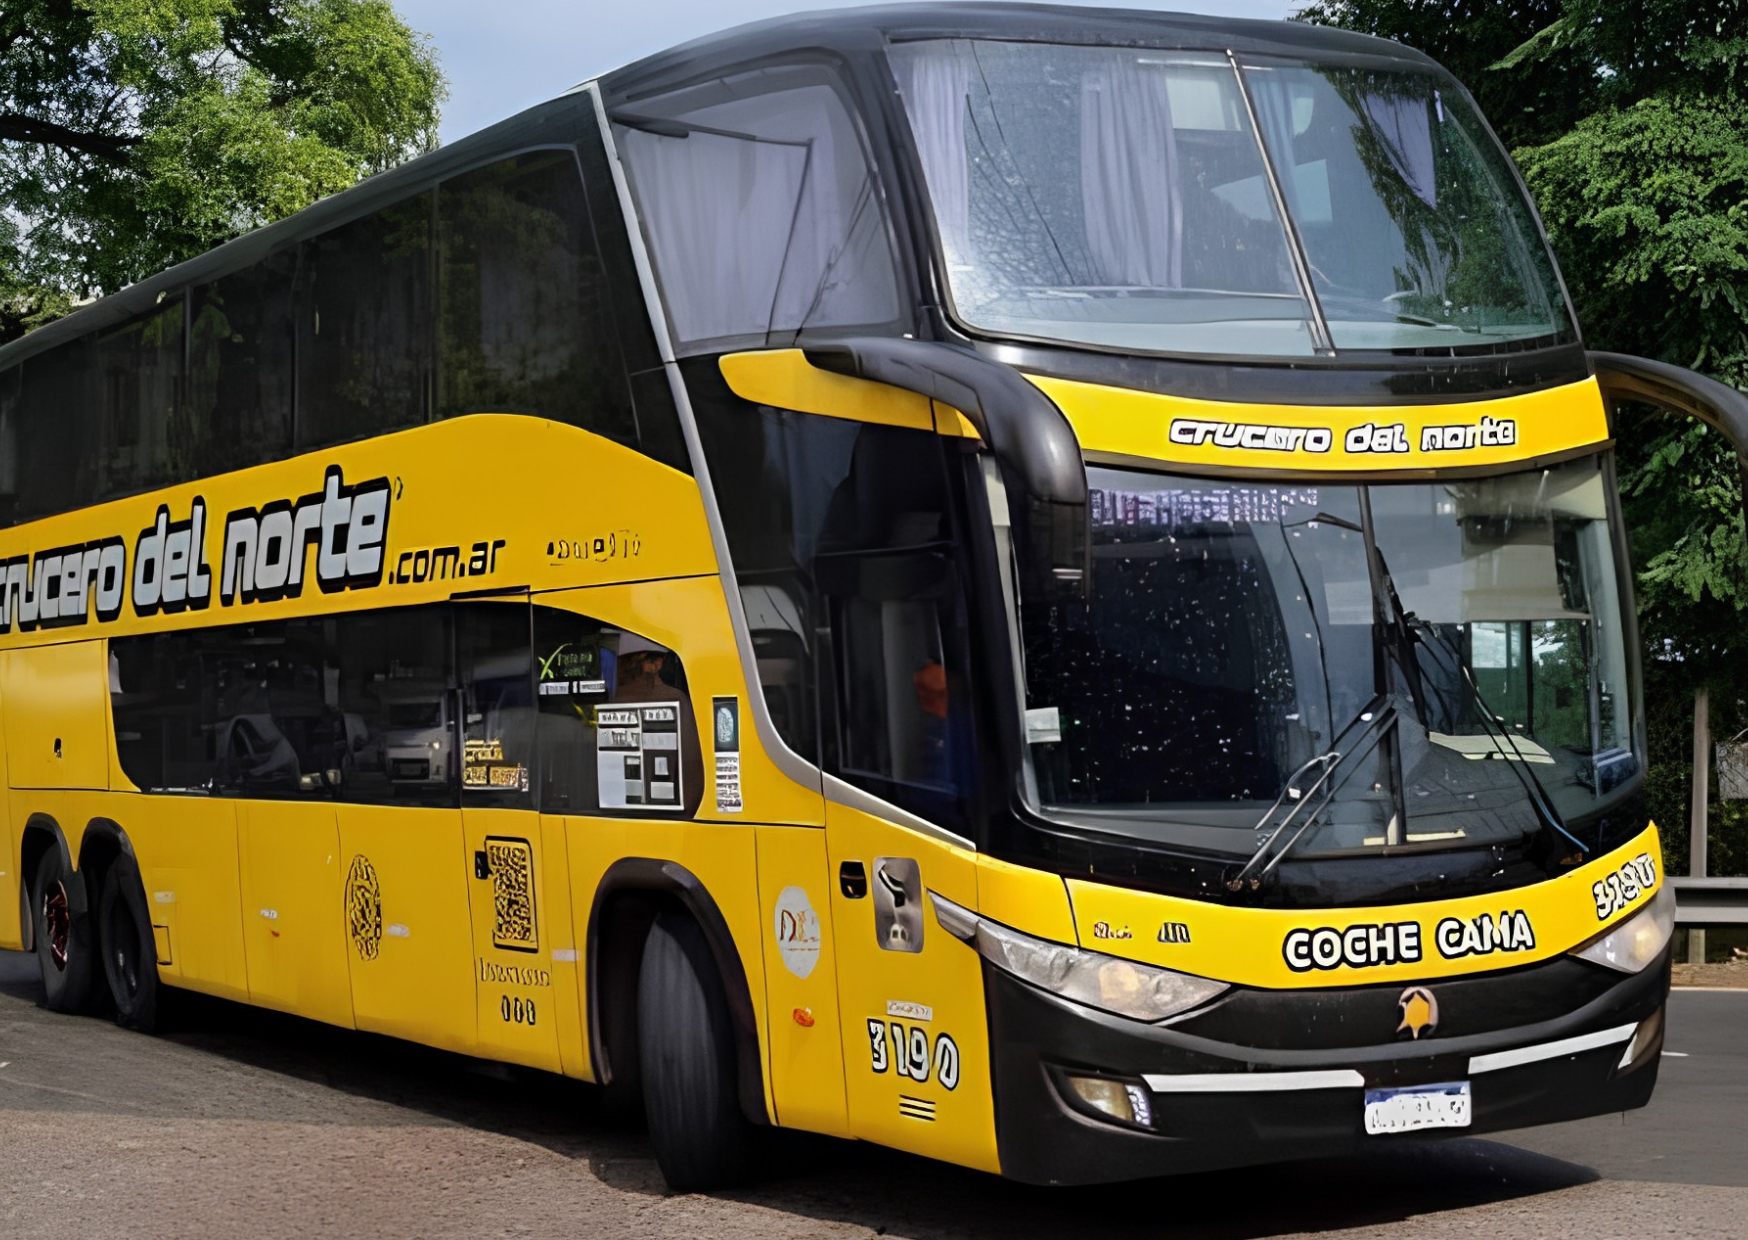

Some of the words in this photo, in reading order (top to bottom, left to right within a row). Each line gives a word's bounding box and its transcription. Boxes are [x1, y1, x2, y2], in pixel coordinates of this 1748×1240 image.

[133, 495, 212, 618] del
[220, 464, 392, 607] norte
[1282, 921, 1422, 973] COCHE
[1435, 909, 1536, 960] CAMA
[867, 1018, 960, 1091] 3190
